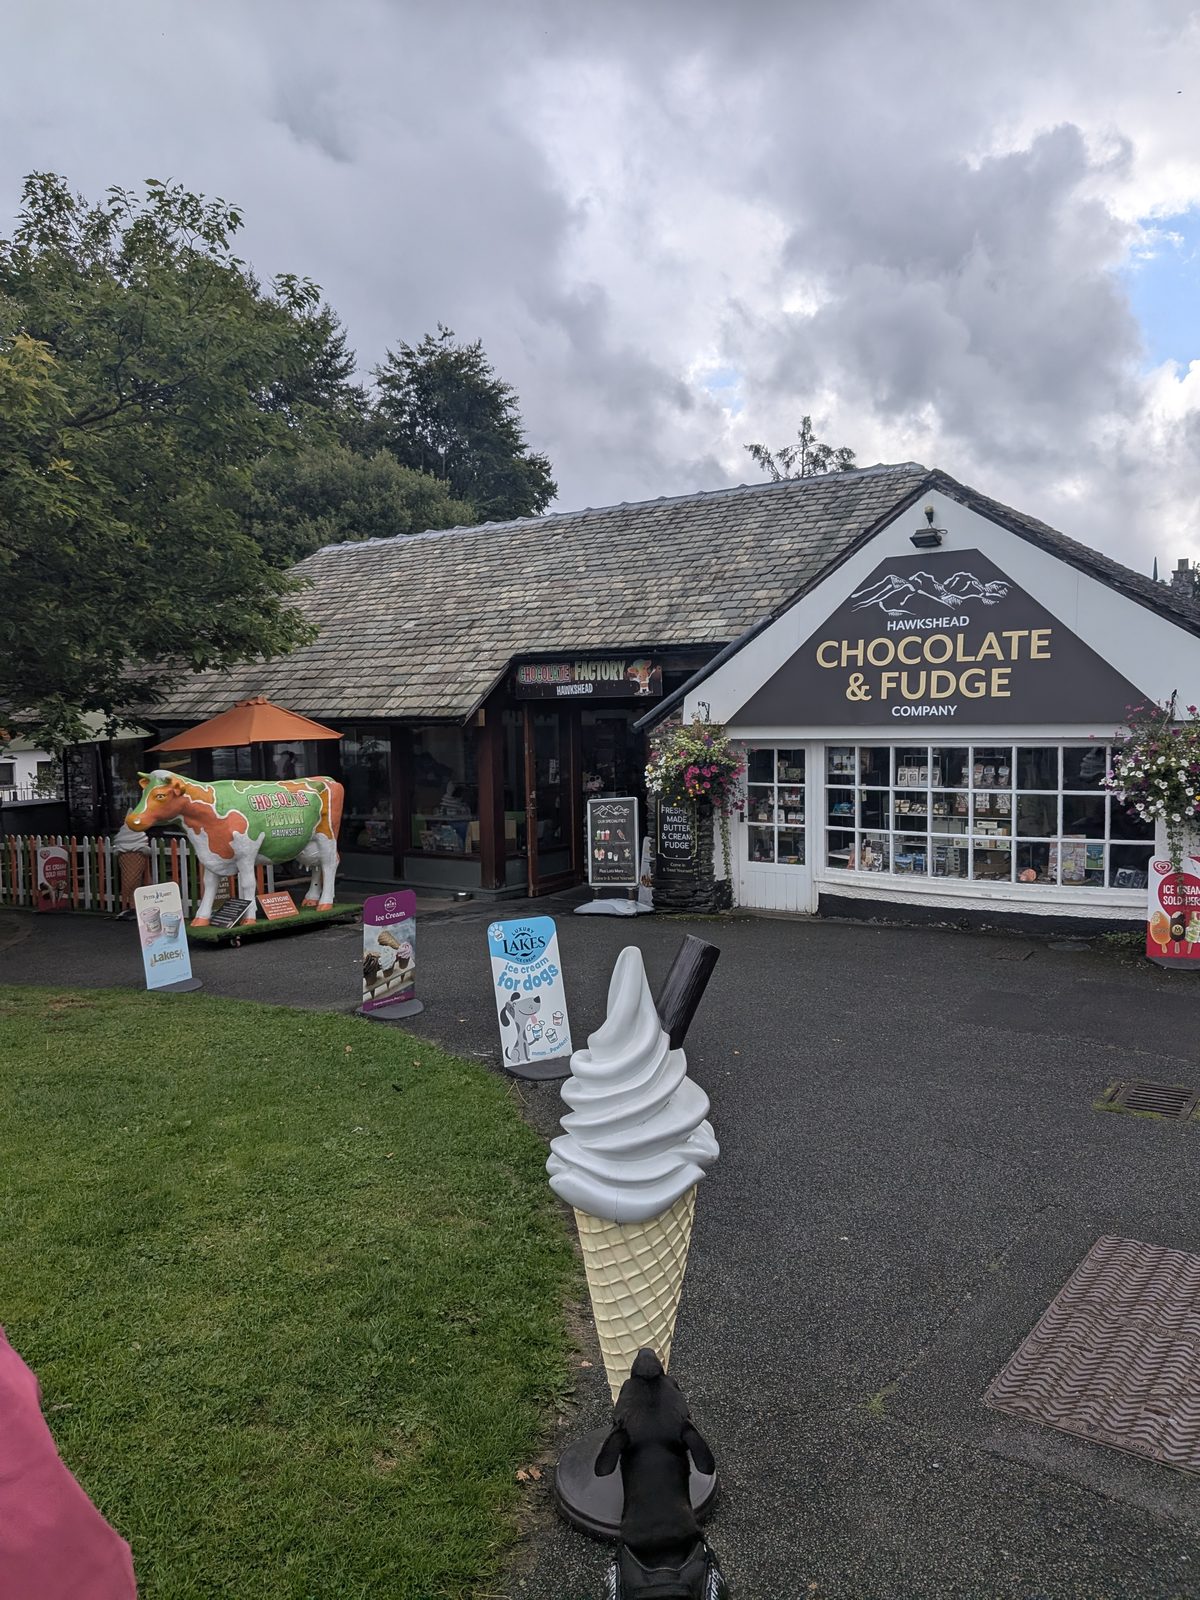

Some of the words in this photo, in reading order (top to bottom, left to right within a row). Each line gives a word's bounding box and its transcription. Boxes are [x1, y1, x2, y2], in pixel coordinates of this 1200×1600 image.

[887, 616, 970, 631] HAWKSHEAD
[816, 628, 1052, 668] CHOCOLATE
[518, 663, 571, 684] CHOCOLATE
[574, 660, 626, 681] FACTORY
[556, 683, 593, 696] HAWKSHEAD
[846, 672, 871, 700] &
[881, 668, 1012, 699] FUDGE
[891, 705, 958, 717] COMPANY
[248, 791, 310, 812] CHOCOLATE
[266, 809, 304, 826] FACTORY
[666, 815, 688, 823] MADE
[271, 828, 304, 838] HAWKSHEAD
[663, 824, 691, 832] BUTTER
[668, 833, 692, 841] CREAM
[664, 841, 690, 849] FUDGE
[1163, 885, 1175, 894] ICE
[1163, 896, 1183, 905] SOLD
[385, 911, 406, 920] Cream
[512, 926, 534, 936] LUXURY
[503, 936, 546, 955] LAKES
[153, 949, 180, 963] Lakes
[504, 962, 519, 974] ice
[520, 957, 549, 974] cream
[497, 971, 520, 991] for
[523, 964, 559, 991] dogs
